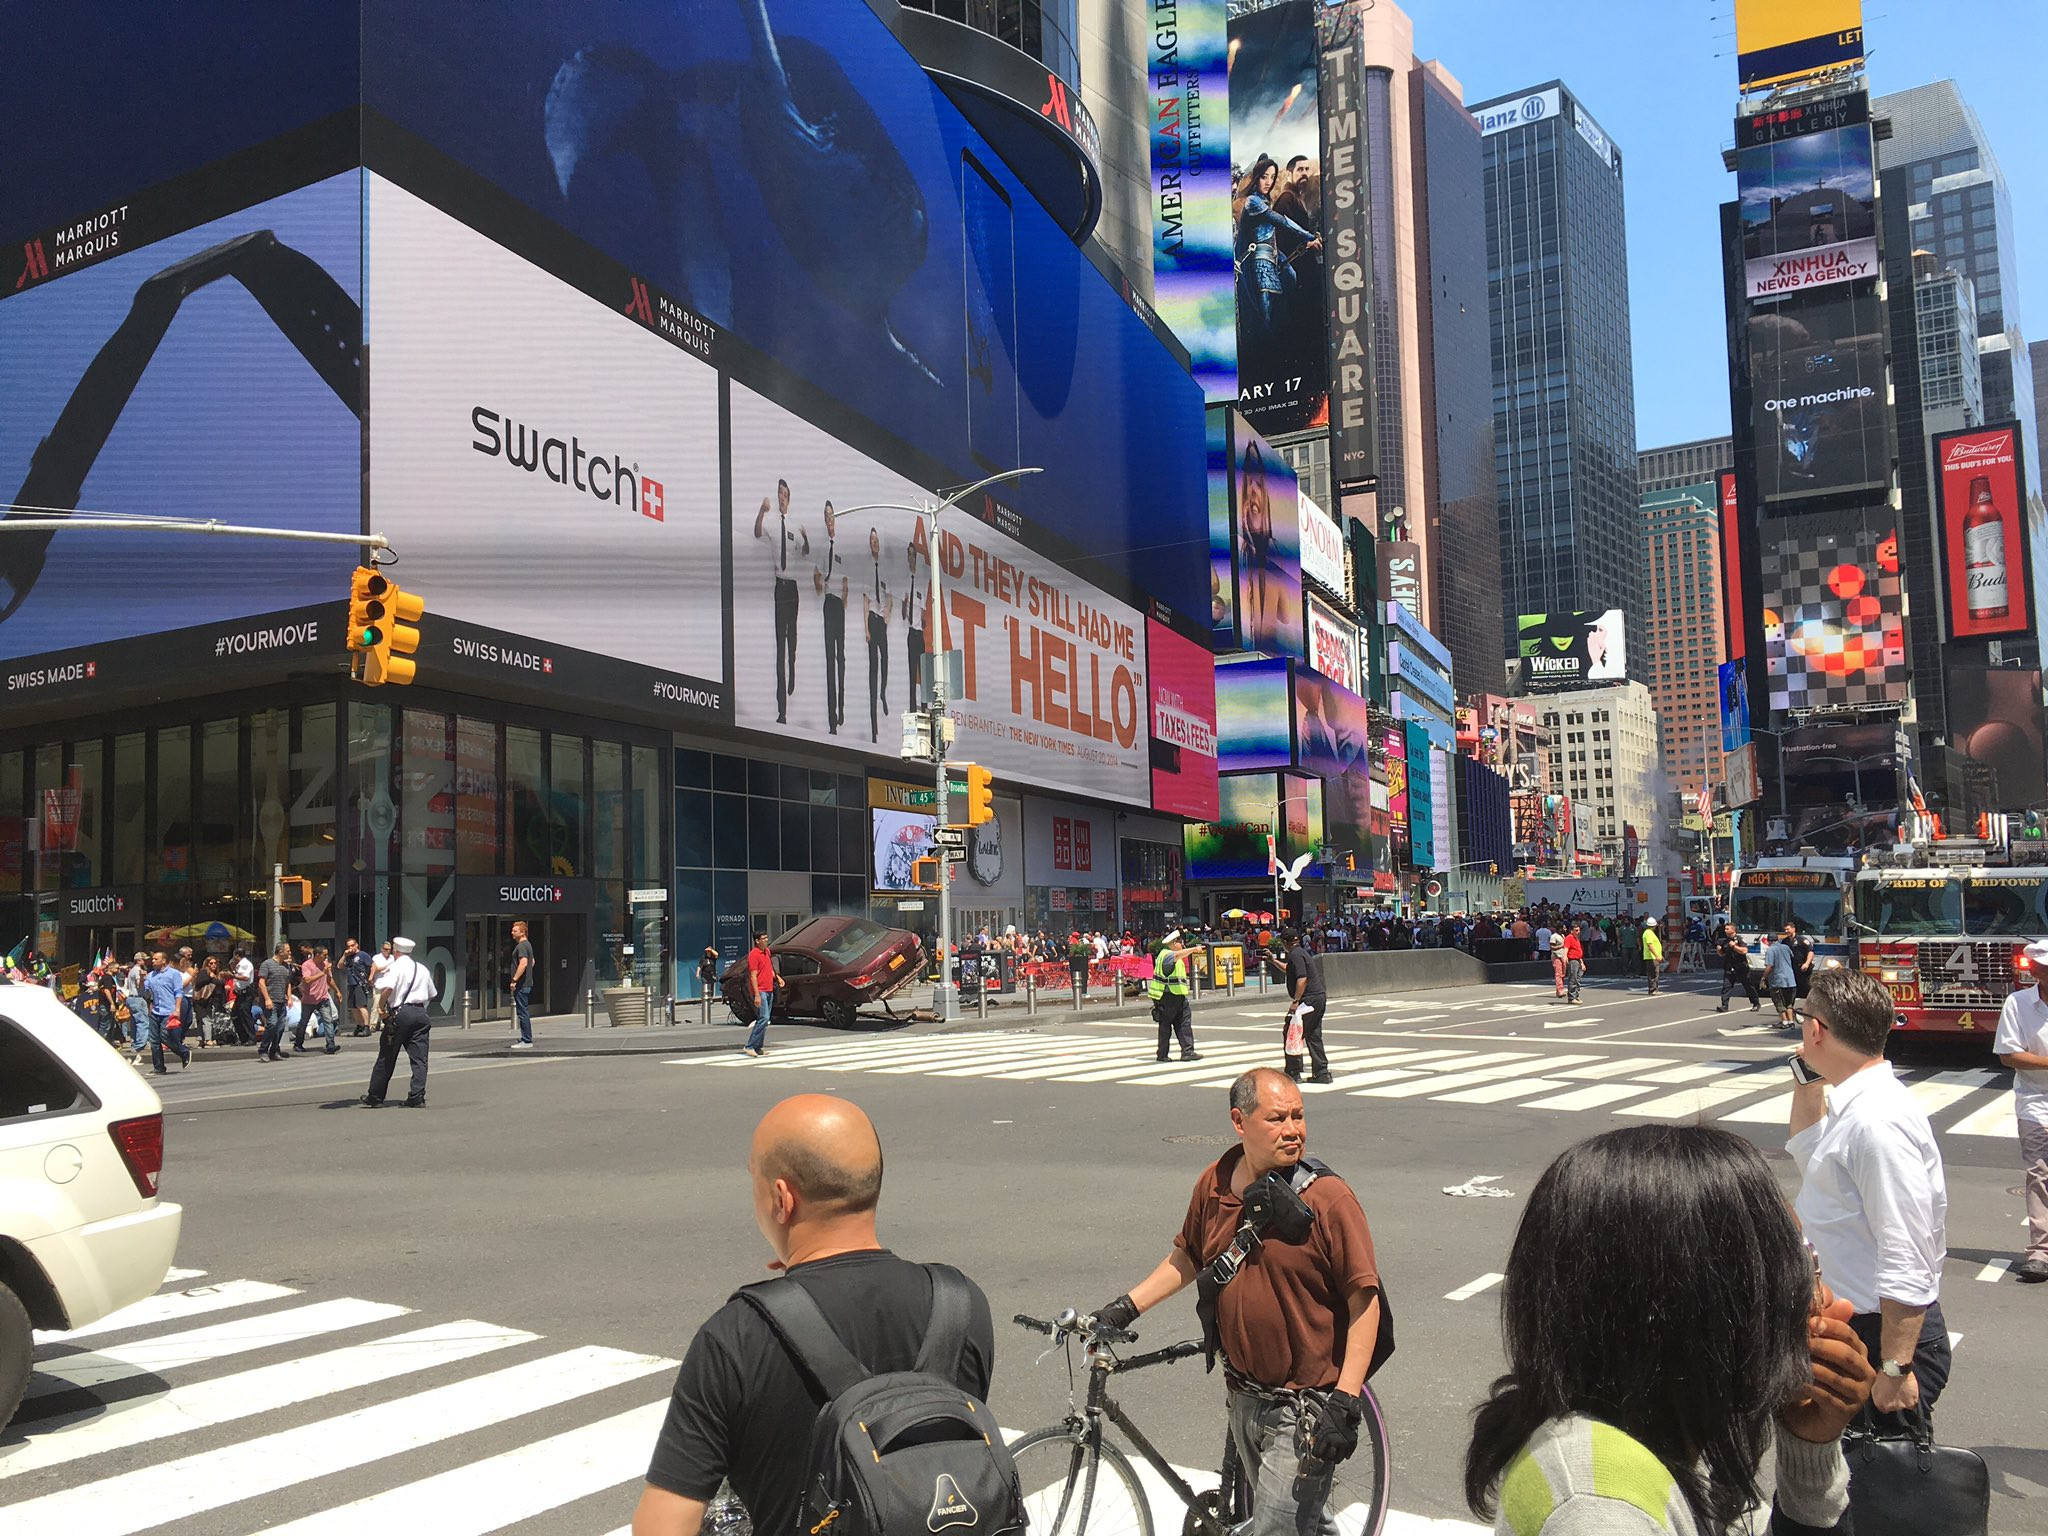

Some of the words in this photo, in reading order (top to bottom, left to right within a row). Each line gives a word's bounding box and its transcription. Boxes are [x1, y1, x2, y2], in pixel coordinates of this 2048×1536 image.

[1838, 29, 1862, 46] LET
[1805, 98, 1847, 116] XINHUA
[1189, 70, 1201, 176] OUTFITTERS
[1326, 46, 1358, 210] TIMES
[1756, 112, 1847, 141] GALLERY
[1158, 98, 1184, 257] AMERICAN
[56, 205, 129, 246] MARRIOTT
[55, 232, 119, 267] MARQUIS
[1773, 250, 1849, 277] XINHUA
[1757, 274, 1800, 292] NEWS
[1804, 262, 1868, 284] AGENCY
[660, 297, 716, 341] MARRIOTT
[1334, 228, 1365, 429] SQUARE
[660, 316, 710, 356] MARQUIS
[1285, 377, 1302, 393] 17
[1268, 402, 1287, 411] IMAX
[1765, 398, 1797, 411] One
[1801, 387, 1875, 406] machine.
[472, 406, 638, 512] swatch
[1344, 450, 1366, 462] NYC
[1953, 442, 2002, 457] Budweiser
[1944, 464, 1960, 472] THIS
[1982, 457, 1996, 466] FOR
[969, 543, 1025, 609] THEY
[1028, 575, 1076, 635] STILL
[1078, 601, 1112, 650] HAD
[1114, 621, 1135, 662] ME
[215, 622, 318, 656] #YOURMOVE
[453, 638, 498, 663] SWISS
[501, 648, 540, 671] MADE
[8, 671, 45, 690] SWISS
[47, 664, 84, 684] MADE
[653, 681, 720, 709] #YOURMOVE
[969, 716, 1006, 738] BRANTLEY
[1009, 727, 1022, 742] THE
[1024, 730, 1039, 747] NEW
[1040, 734, 1056, 751] YORK
[1057, 741, 1075, 756] TIMES
[1077, 746, 1098, 762] AUGUST
[1160, 711, 1186, 743] TAXES
[1191, 723, 1210, 752] FEES
[920, 793, 928, 803] 45
[950, 833, 959, 841] WAY
[1075, 826, 1088, 844] UNI
[1076, 848, 1090, 867] QLO
[500, 885, 554, 902] swatch
[1929, 879, 1948, 888] OF
[70, 894, 117, 914] swatch
[717, 914, 746, 923] VORNADO
[1945, 945, 1979, 981] 4
[1958, 1012, 1974, 1030] 4
[937, 1504, 967, 1516] FANCIER
